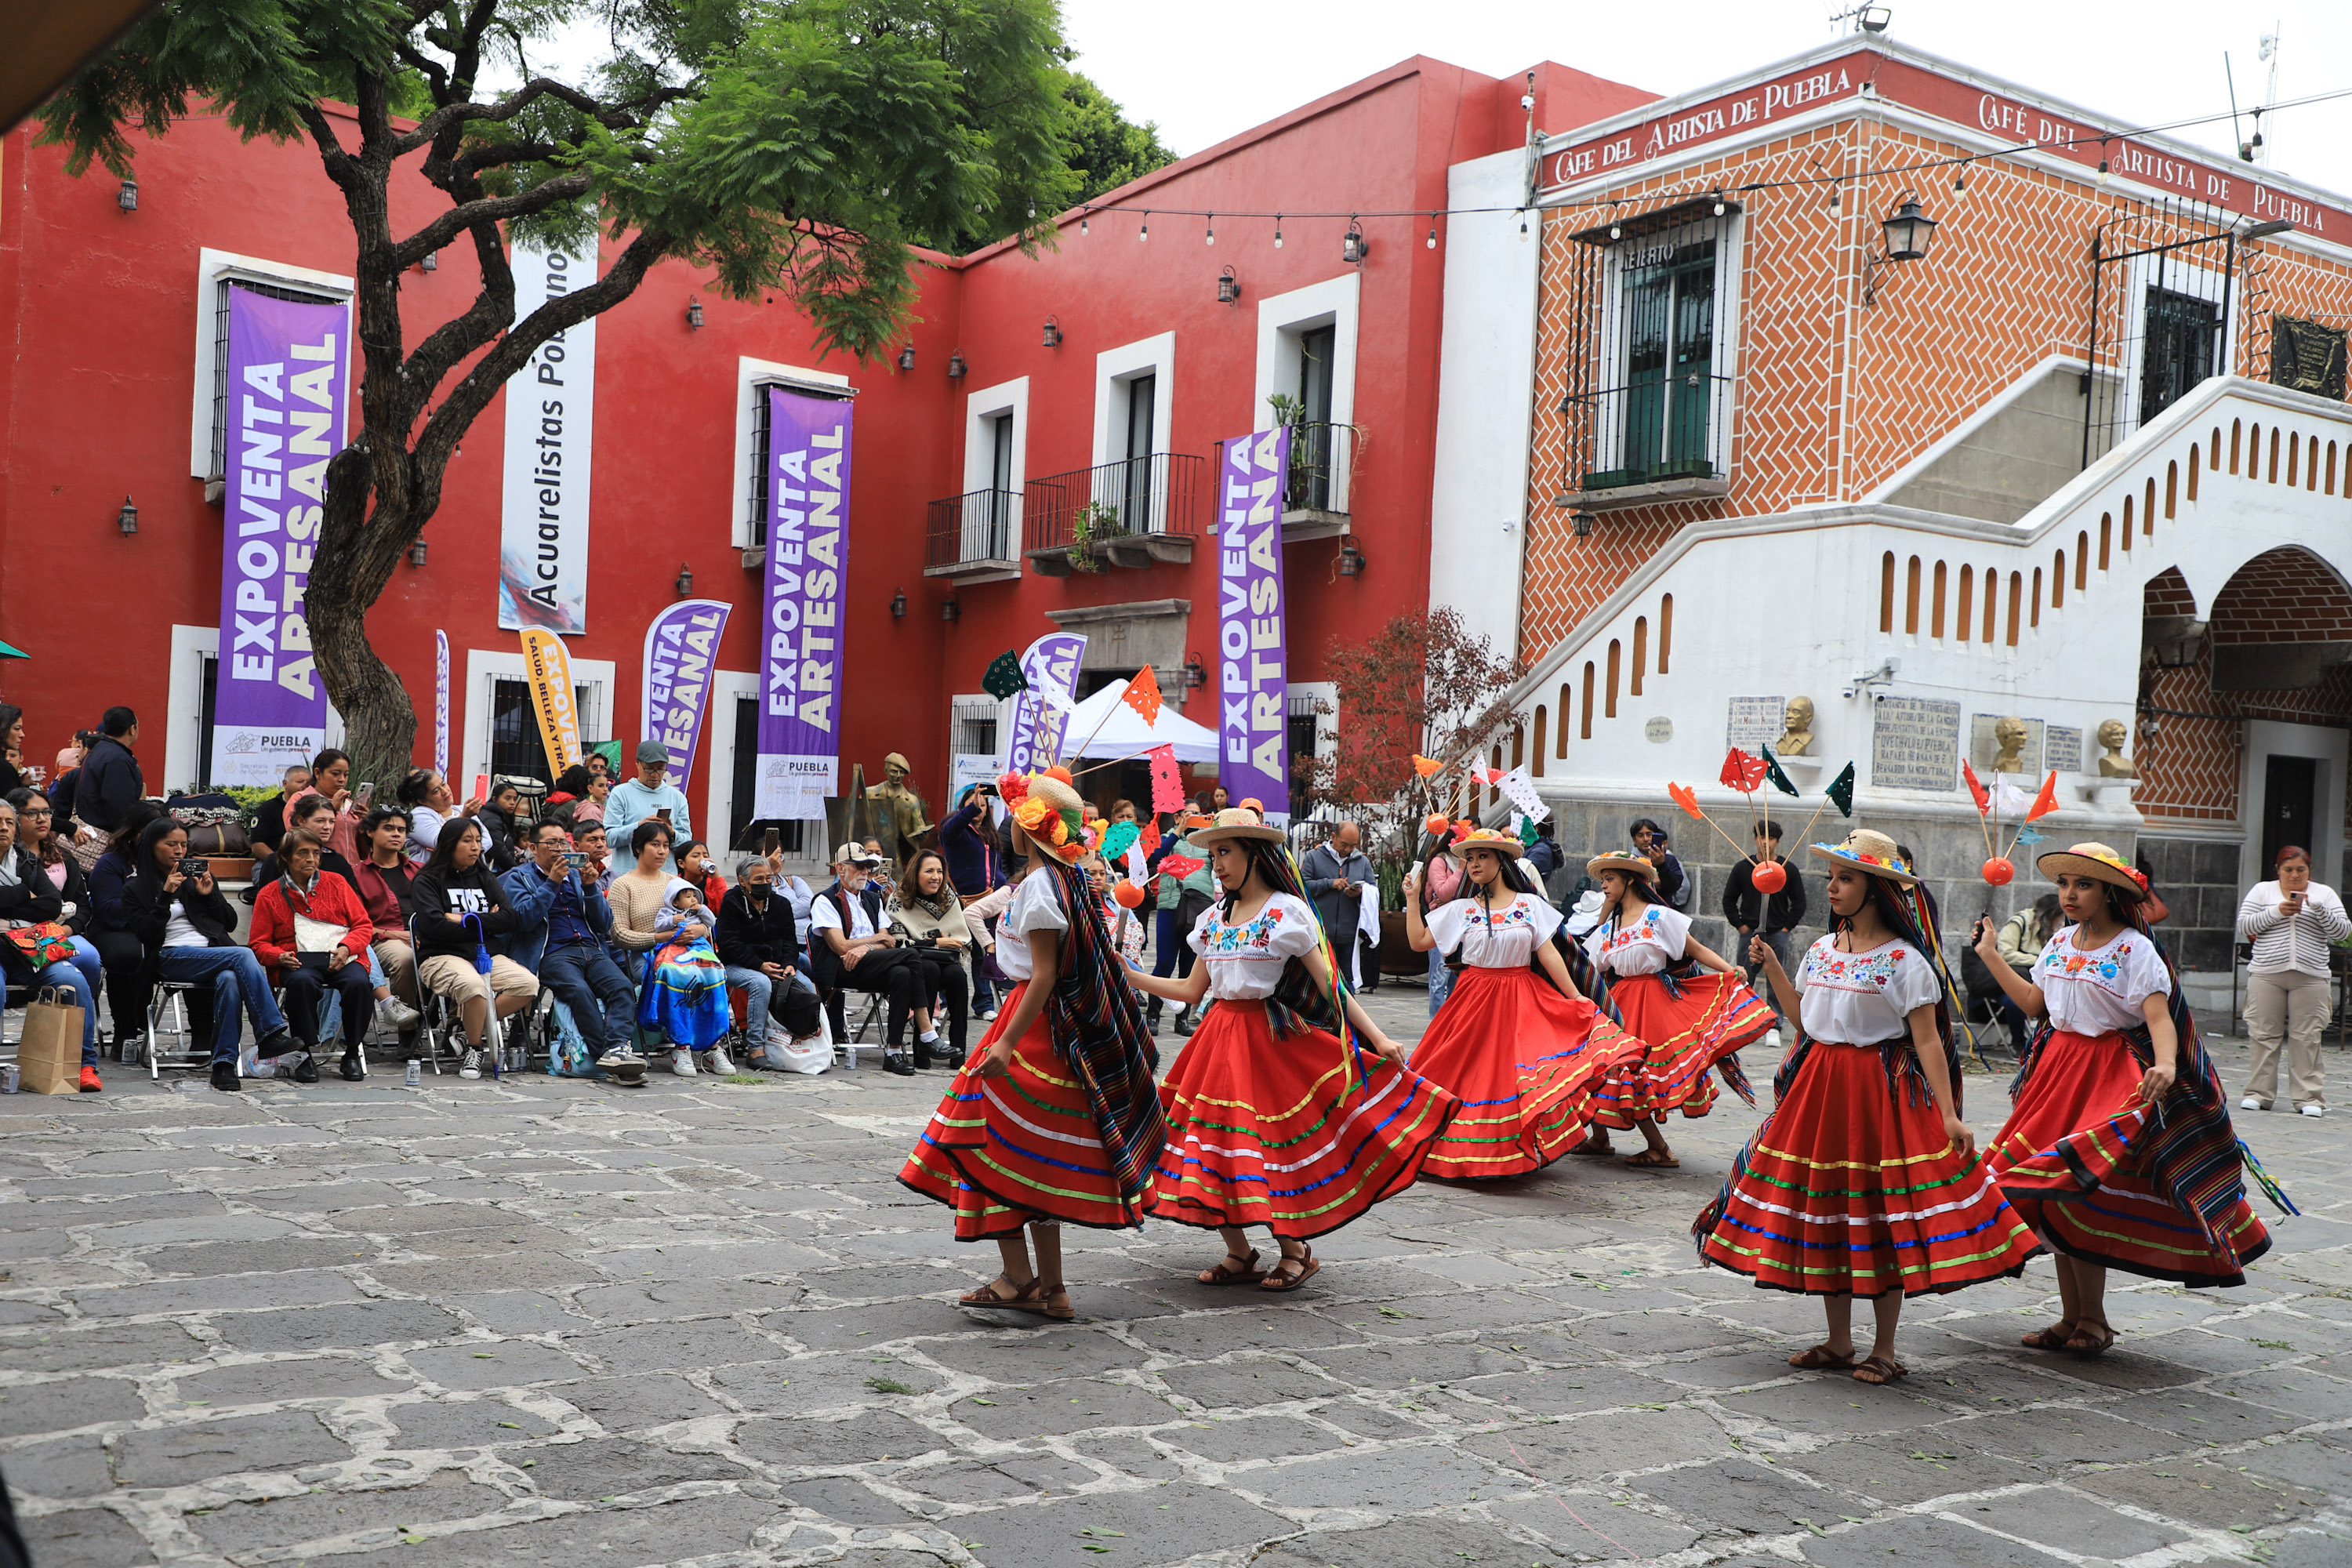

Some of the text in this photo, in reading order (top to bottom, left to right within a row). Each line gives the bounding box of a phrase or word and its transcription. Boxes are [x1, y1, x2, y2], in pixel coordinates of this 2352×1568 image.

[1602, 137, 1636, 167] DEL
[1644, 108, 1726, 162] ARTISTA
[1730, 97, 1759, 127] DE
[1763, 67, 1851, 120] PUEBLA
[1978, 93, 2325, 231] CAFÉ DEL ARTISTA DE PUEBLA
[232, 362, 284, 681] EXPOVENTA
[278, 333, 336, 701] ARTESANAL
[528, 399, 564, 608] Acuarelistas
[768, 449, 808, 717] EXPOVENTA
[799, 425, 844, 734] ARTESANAL
[1222, 434, 1253, 764] EXPOVENTA
[261, 735, 311, 747] PUEBLA
[529, 637, 543, 681] SALUD,
[539, 683, 556, 733] BELLEZA
[551, 733, 559, 742] Y
[543, 643, 580, 765] EXPOVEN
[789, 762, 829, 772] PUEBLA
